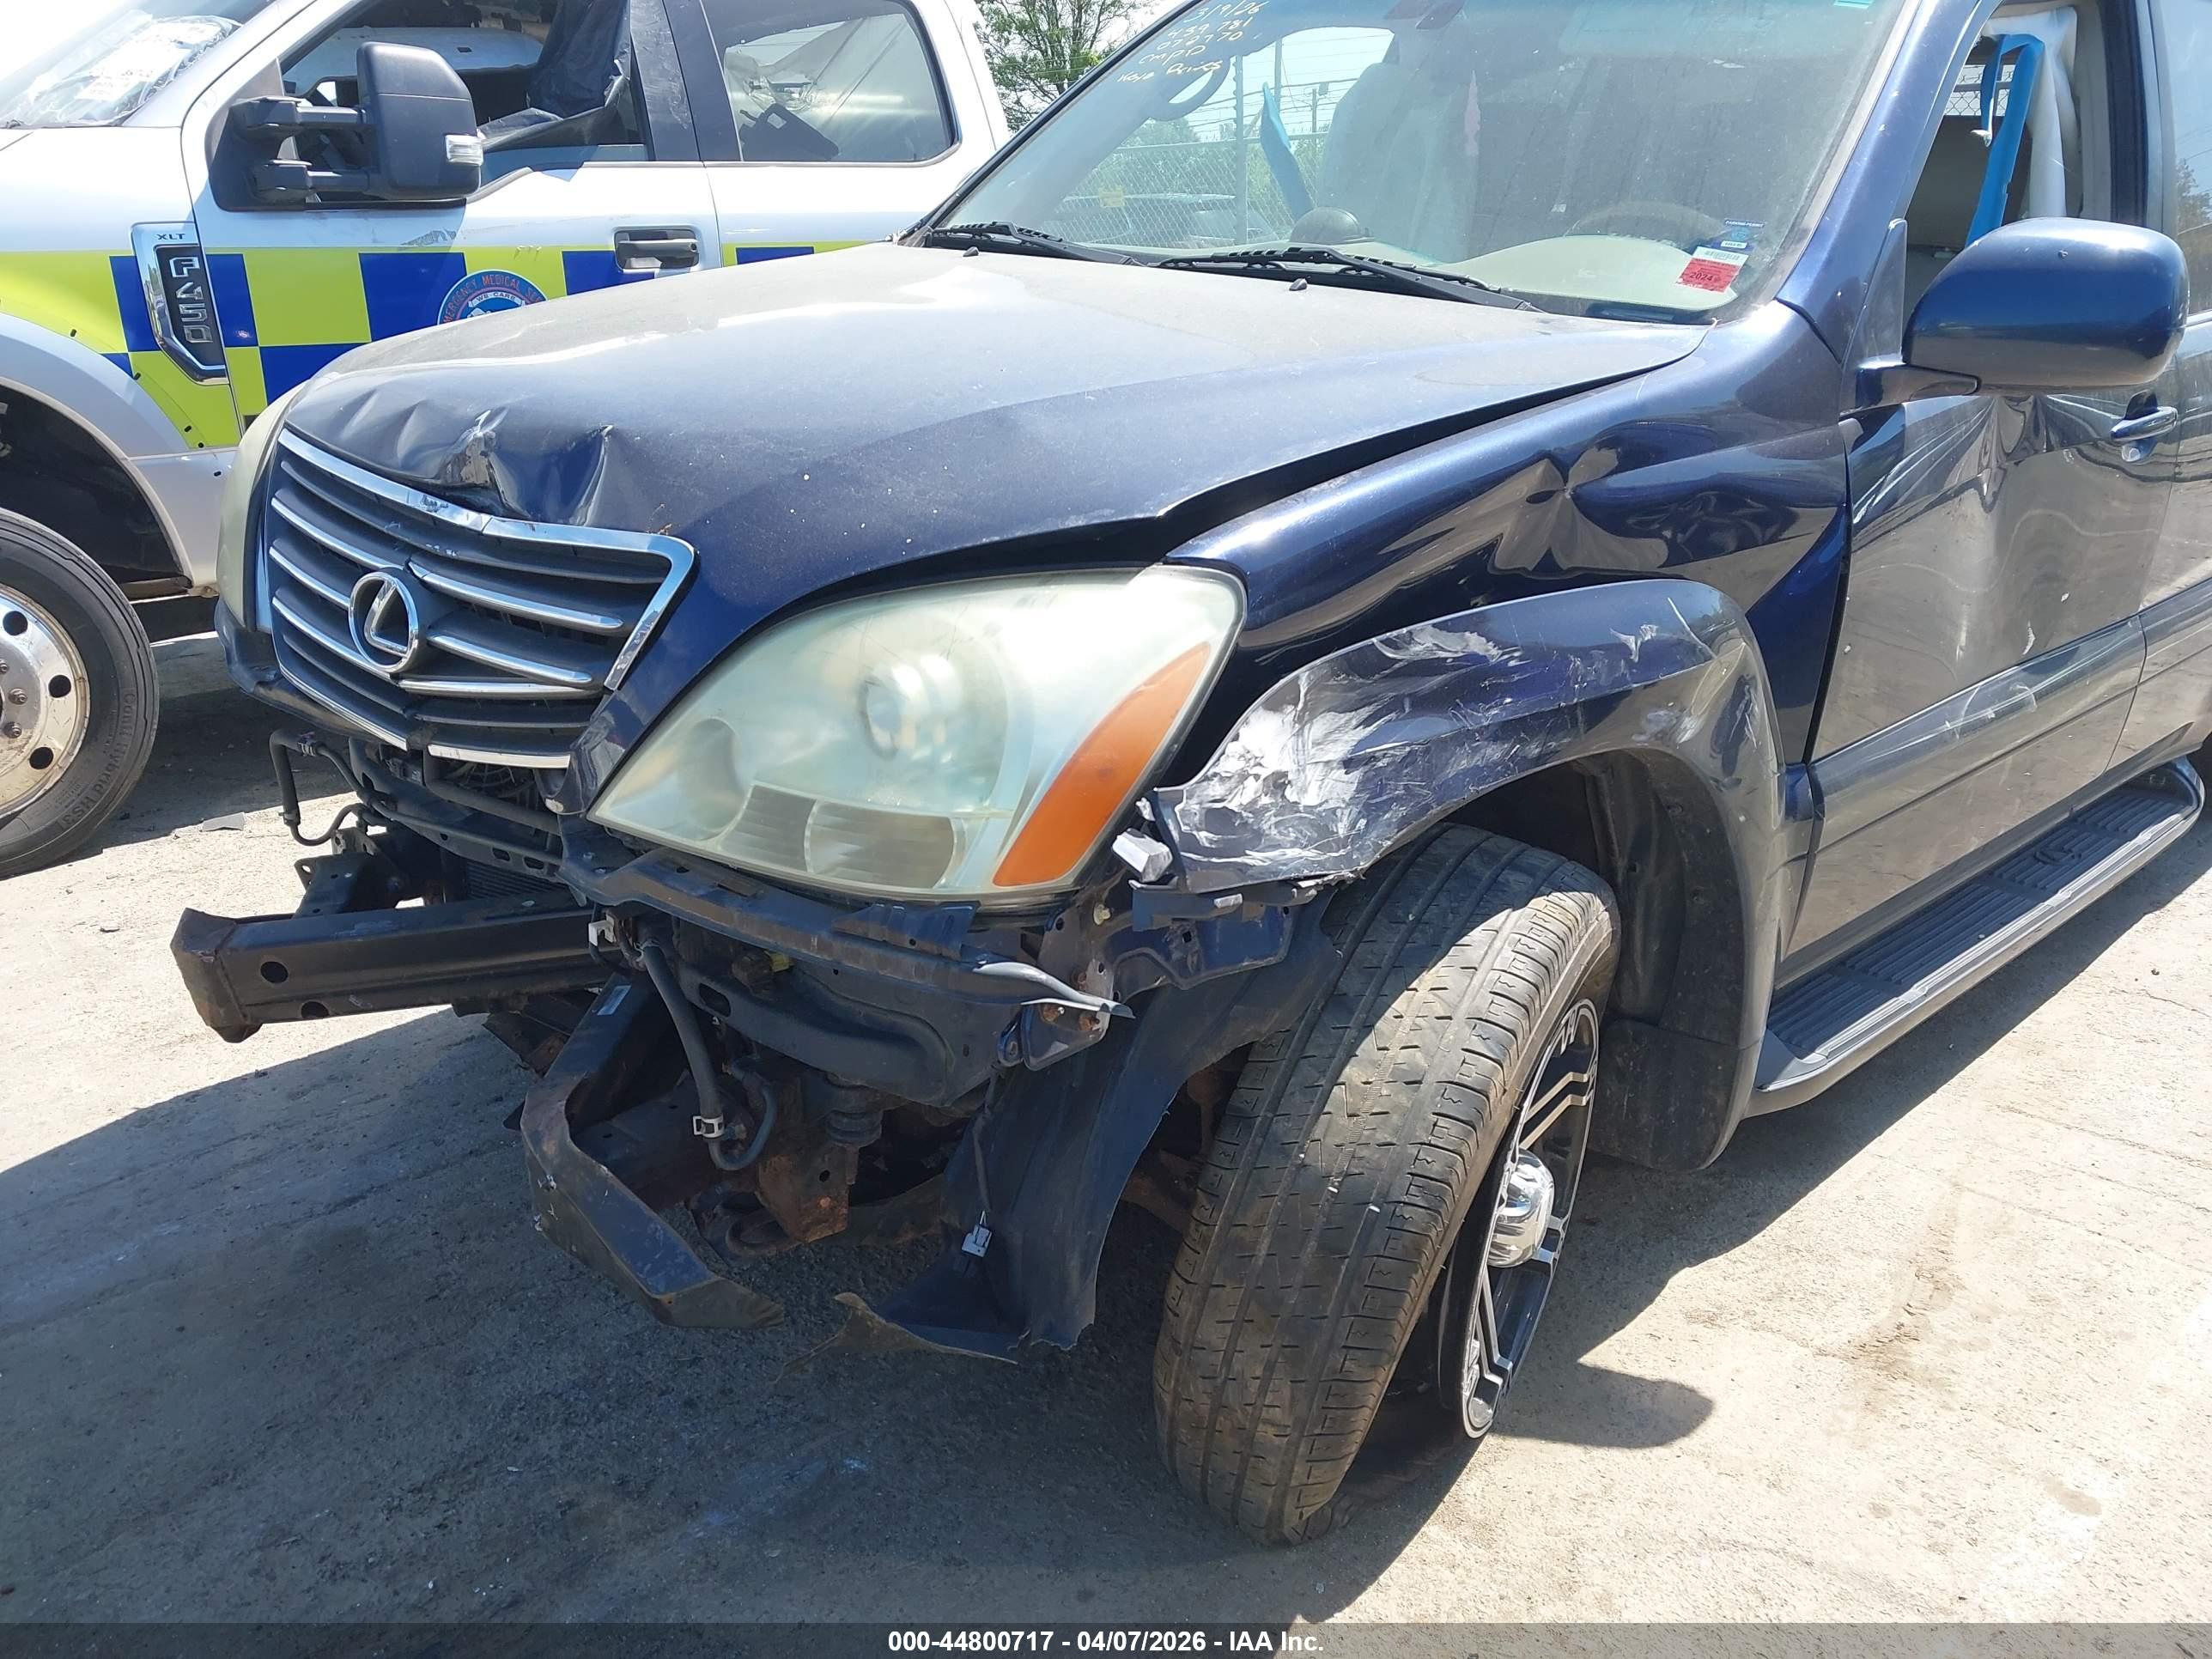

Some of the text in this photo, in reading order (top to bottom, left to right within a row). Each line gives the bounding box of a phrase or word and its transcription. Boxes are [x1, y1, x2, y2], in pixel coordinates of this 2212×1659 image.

[169, 257, 213, 343] F450
[443, 274, 520, 323] MERGENCY MEDICAL
[493, 292, 516, 301] CARE
